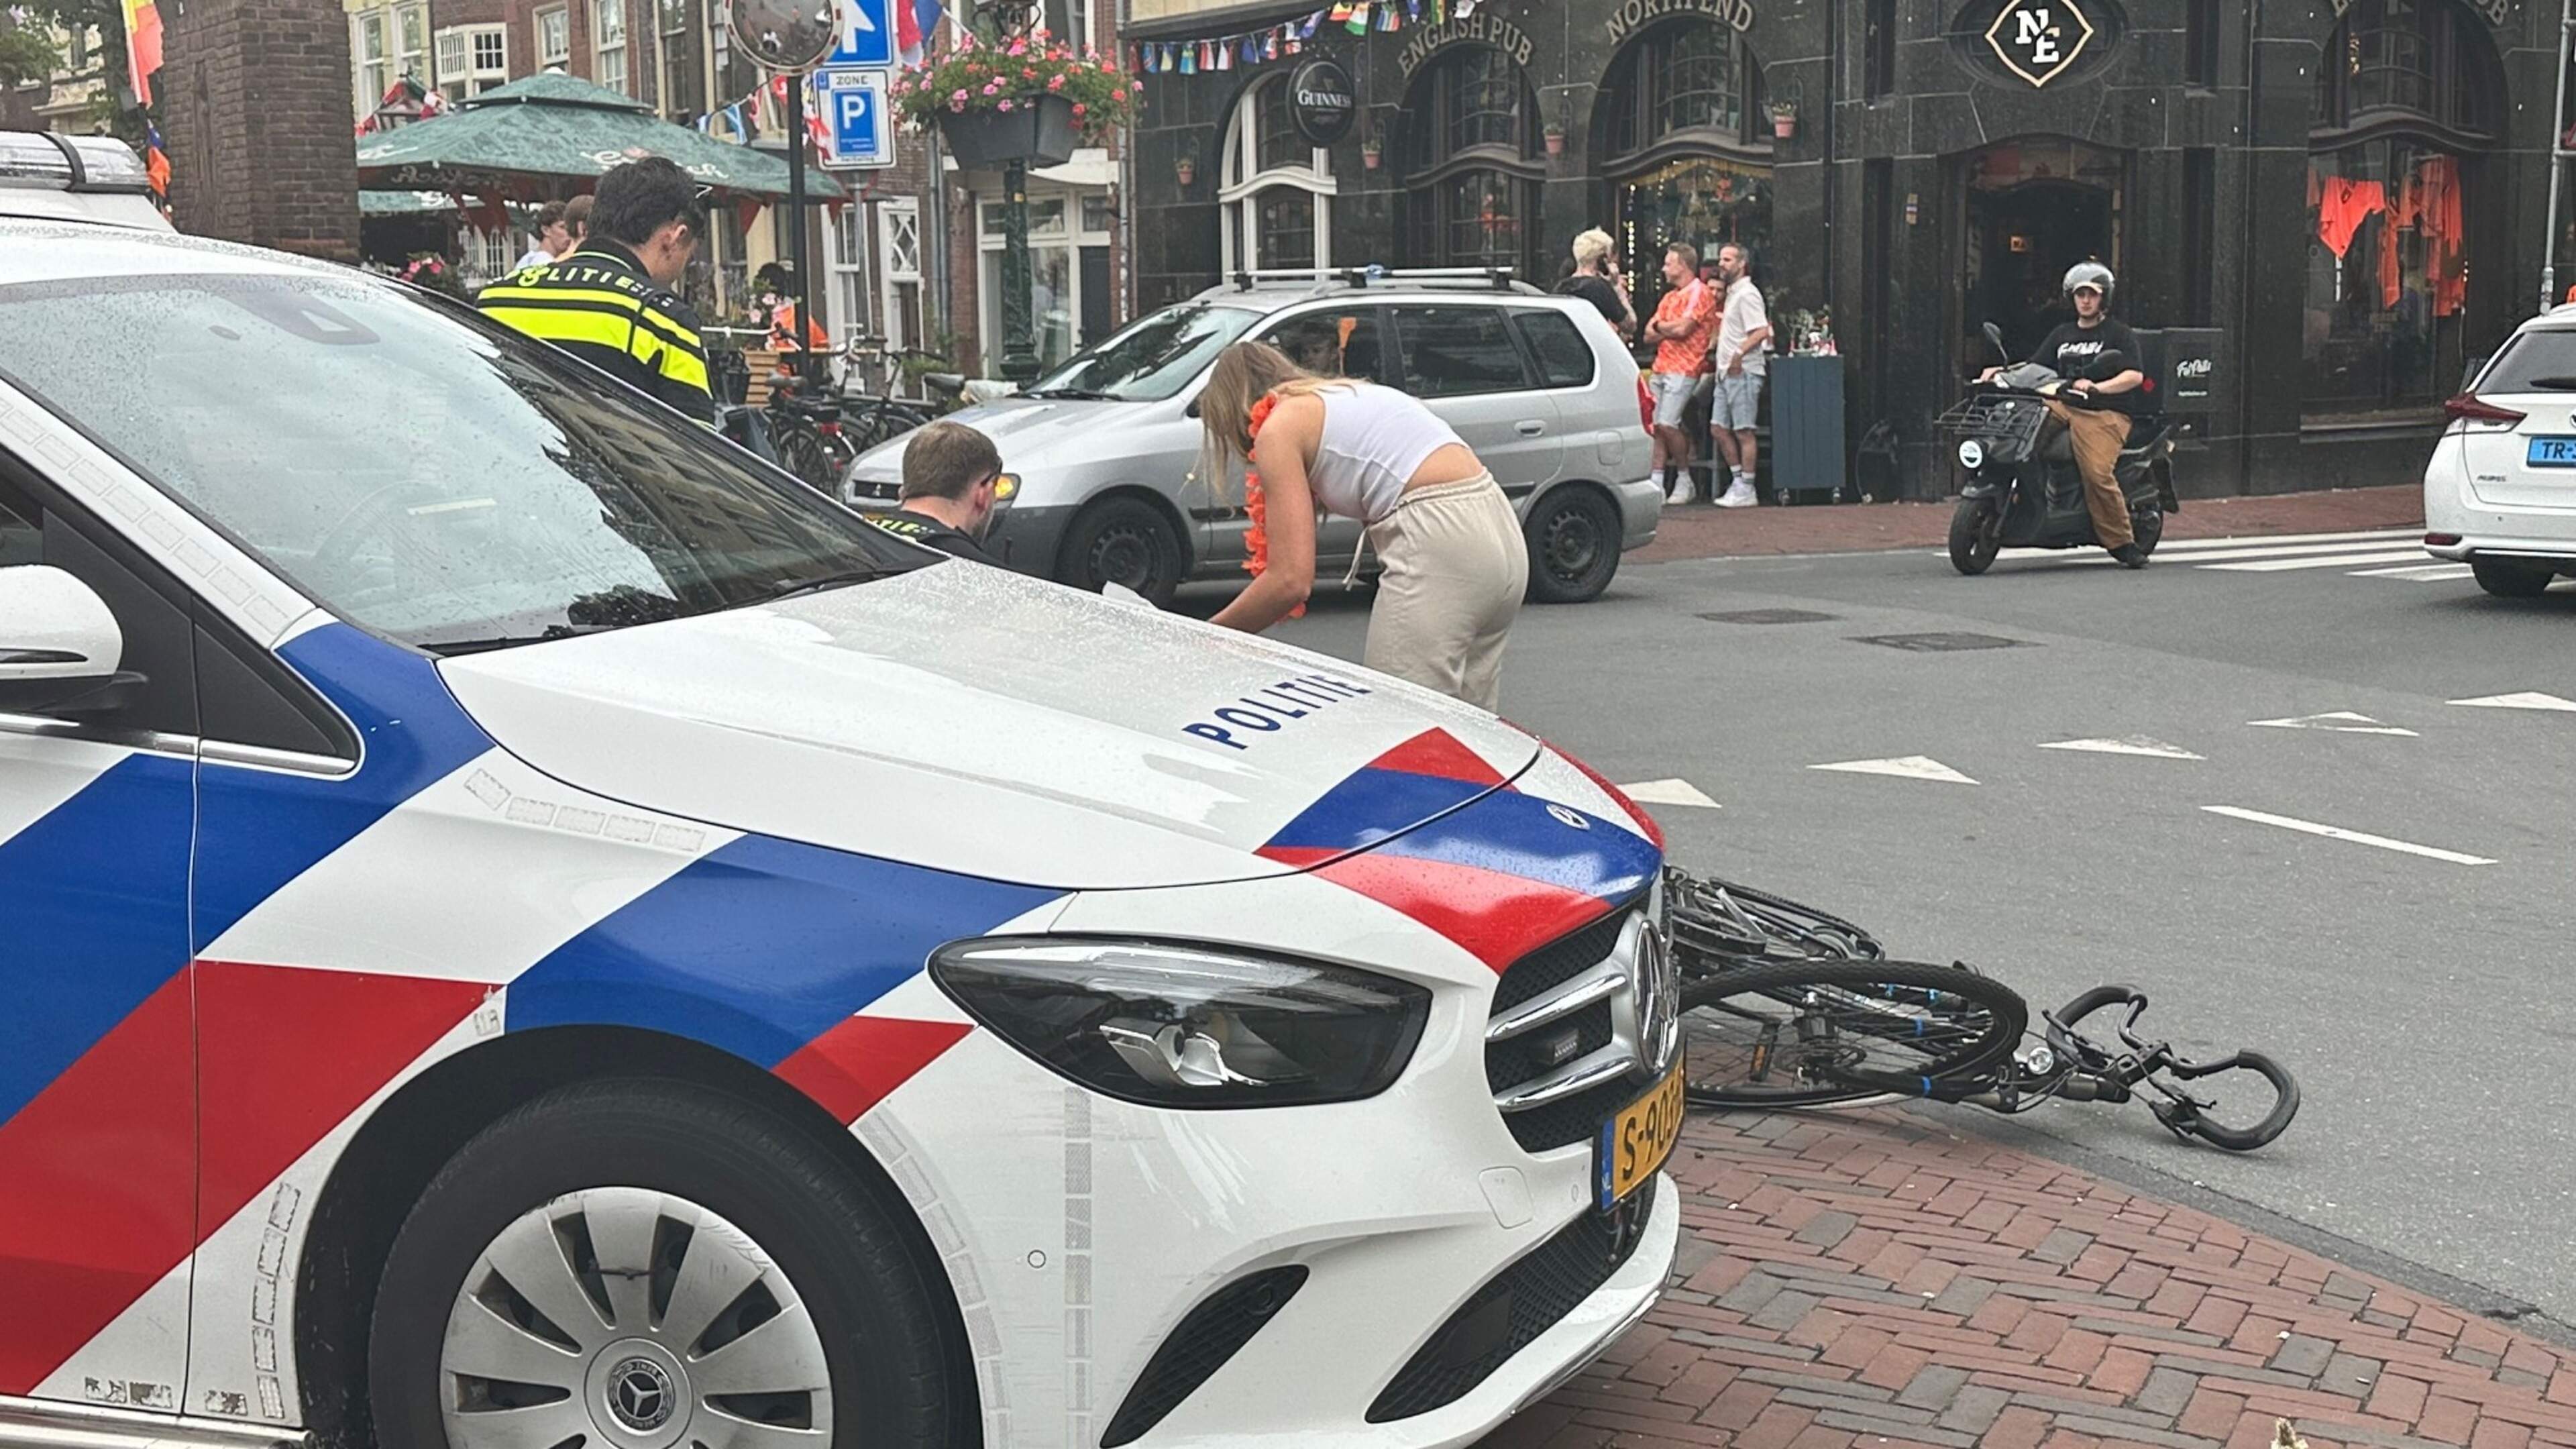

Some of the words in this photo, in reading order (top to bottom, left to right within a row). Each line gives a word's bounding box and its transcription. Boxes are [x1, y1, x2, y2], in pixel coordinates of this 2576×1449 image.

[1397, 12, 1485, 78] ENGLISH
[1489, 15, 1533, 66] PUB
[836, 75, 868, 85] ZONE
[842, 95, 865, 129] P
[1297, 89, 1352, 107] GUINNESS
[1181, 674, 1373, 750] POLITIE
